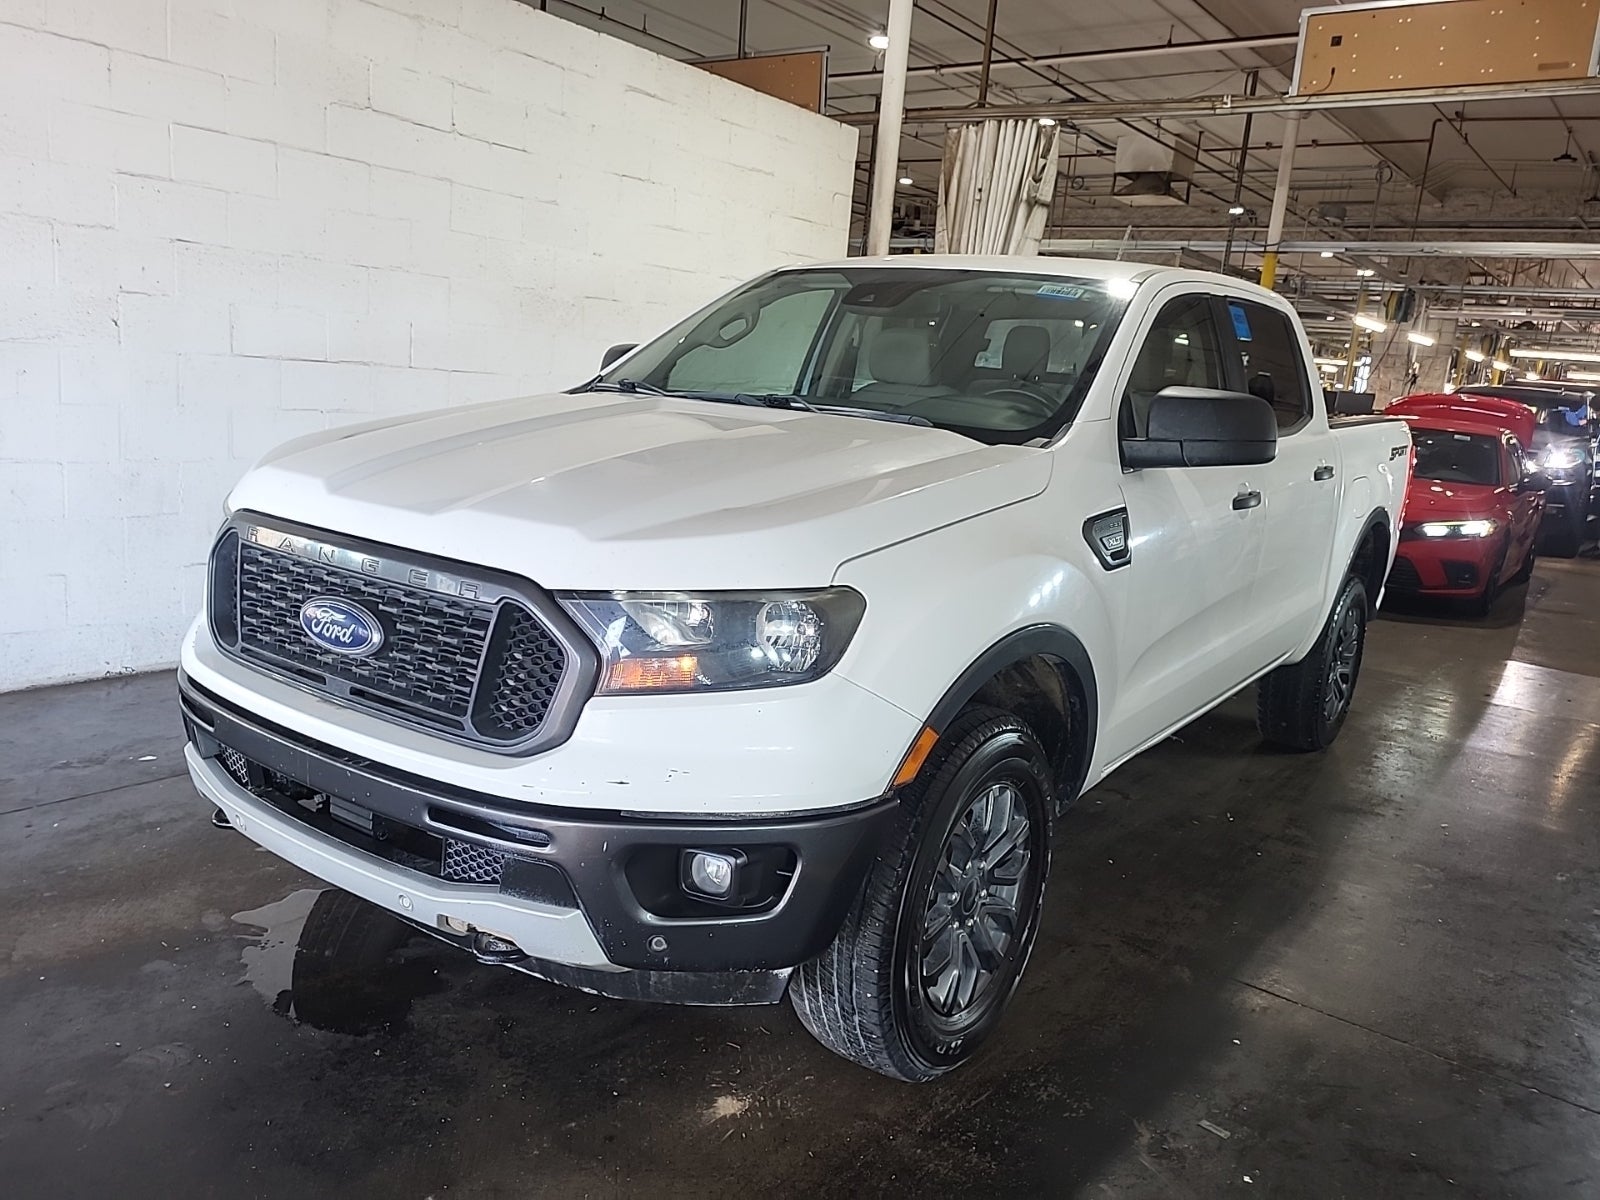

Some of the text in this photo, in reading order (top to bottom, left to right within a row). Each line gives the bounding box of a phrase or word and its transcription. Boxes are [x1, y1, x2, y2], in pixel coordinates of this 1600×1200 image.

[1108, 535, 1122, 547] XLT
[247, 526, 481, 599] RANGER
[311, 607, 357, 644] Ford
